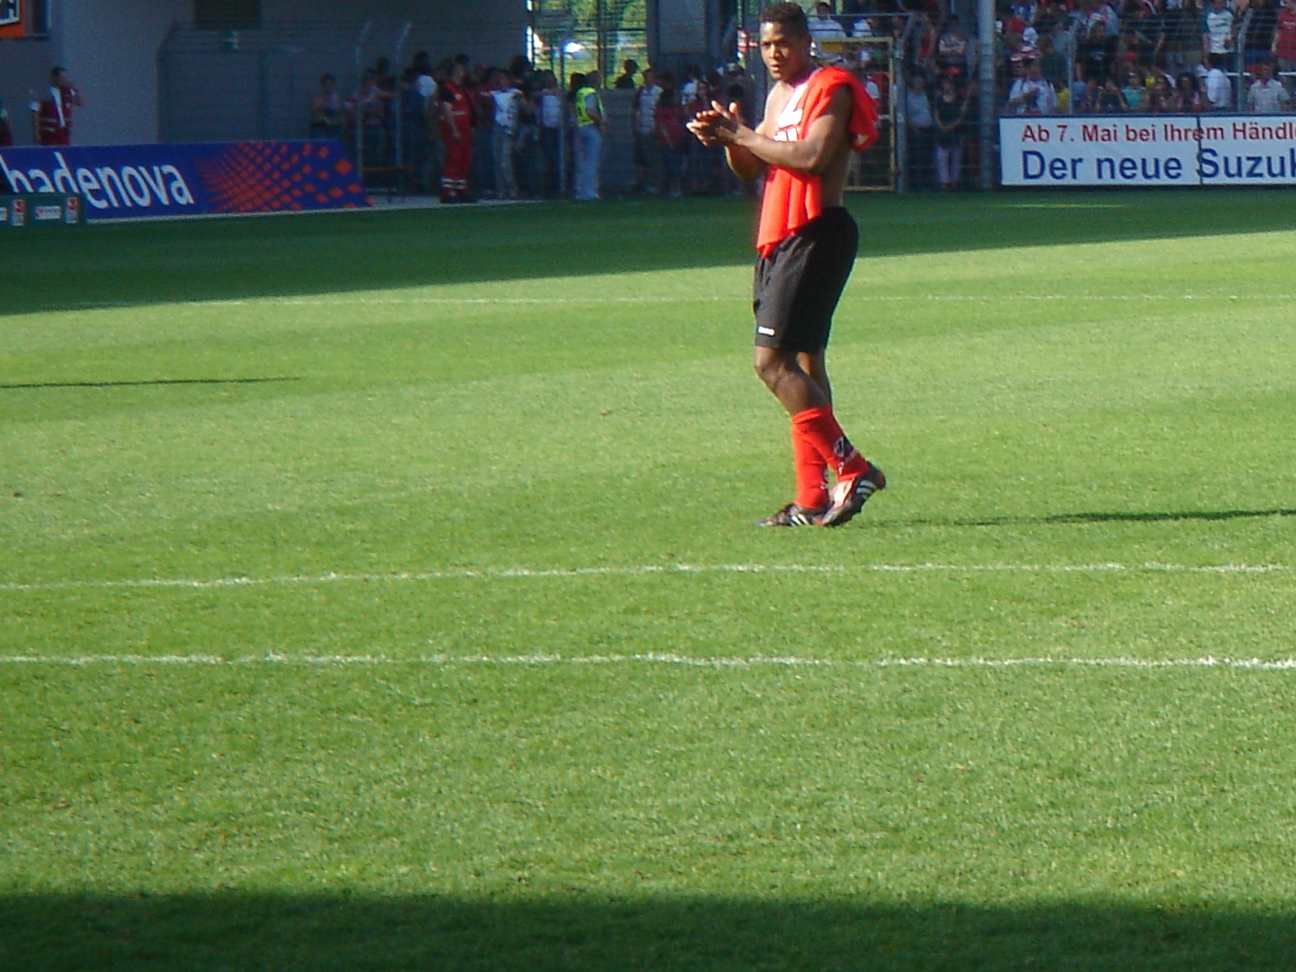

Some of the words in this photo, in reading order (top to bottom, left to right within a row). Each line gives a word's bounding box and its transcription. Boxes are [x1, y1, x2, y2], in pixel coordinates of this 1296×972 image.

[1021, 124, 1050, 142] Ab
[1057, 124, 1075, 142] 7.
[1082, 124, 1118, 142] Mai
[1125, 124, 1157, 142] bei
[1163, 123, 1225, 142] Ihrem
[1021, 149, 1084, 180] Der
[1096, 156, 1182, 180] neue
